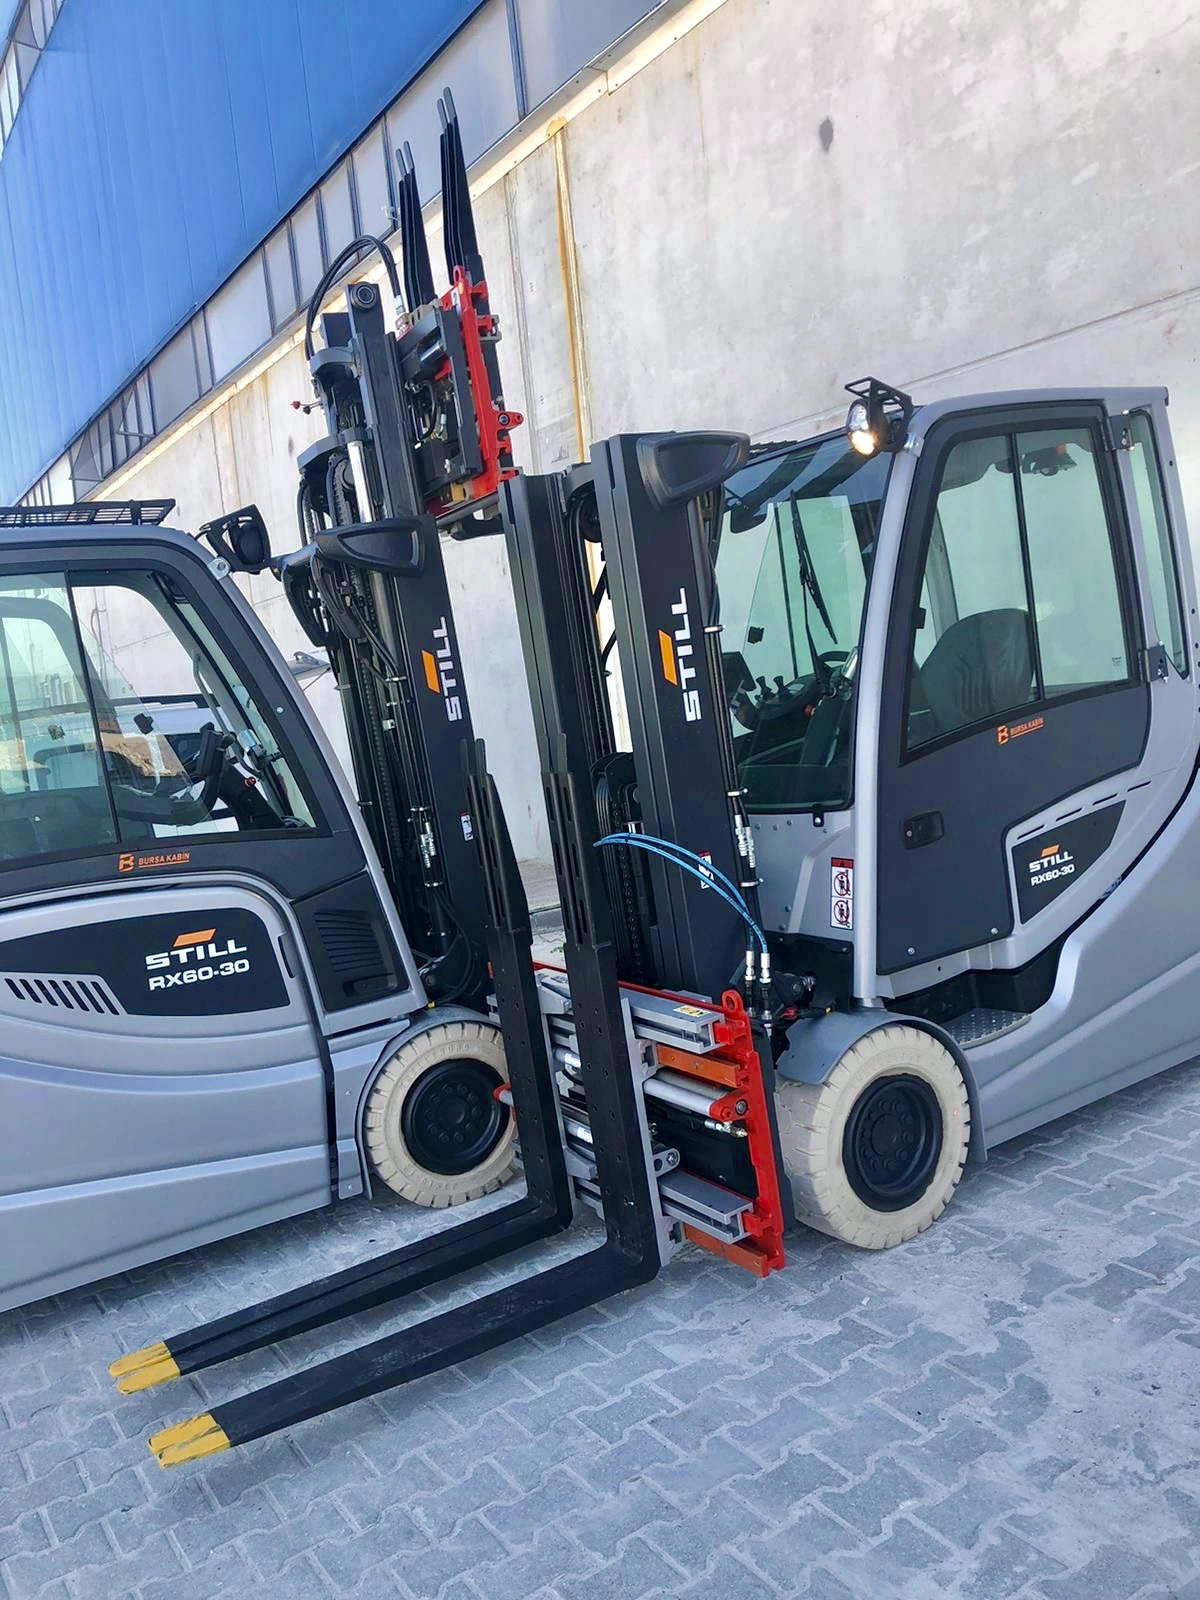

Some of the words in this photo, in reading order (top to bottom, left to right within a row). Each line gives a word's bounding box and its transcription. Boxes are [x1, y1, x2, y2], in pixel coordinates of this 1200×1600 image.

[433, 616, 462, 722] STILL
[671, 587, 702, 722] STILL
[138, 855, 165, 866] BURSA
[1028, 851, 1074, 873] STILL
[1030, 863, 1075, 886] RX60-30
[145, 939, 248, 971] STILL
[148, 959, 250, 991] RX60-30
